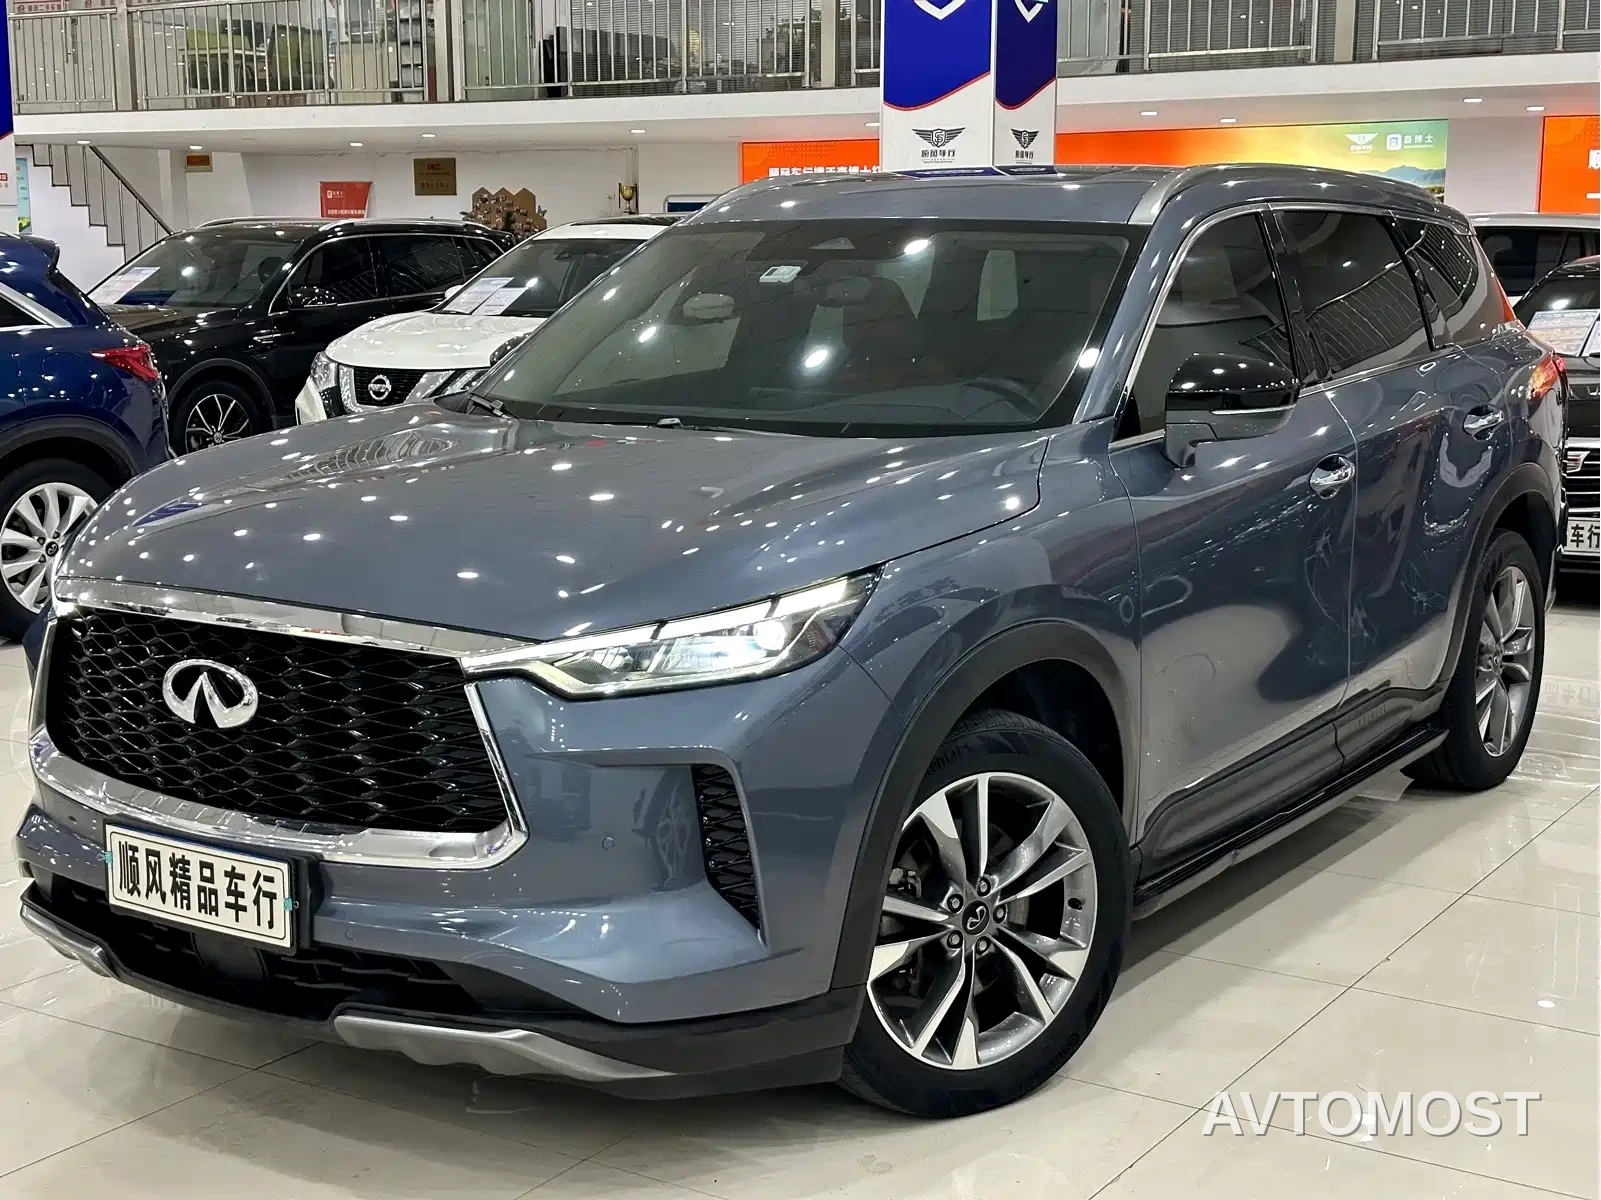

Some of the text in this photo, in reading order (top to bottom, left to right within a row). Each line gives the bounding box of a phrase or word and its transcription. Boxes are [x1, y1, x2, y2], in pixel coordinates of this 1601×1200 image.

[118, 840, 278, 930] 顺风精品车行
